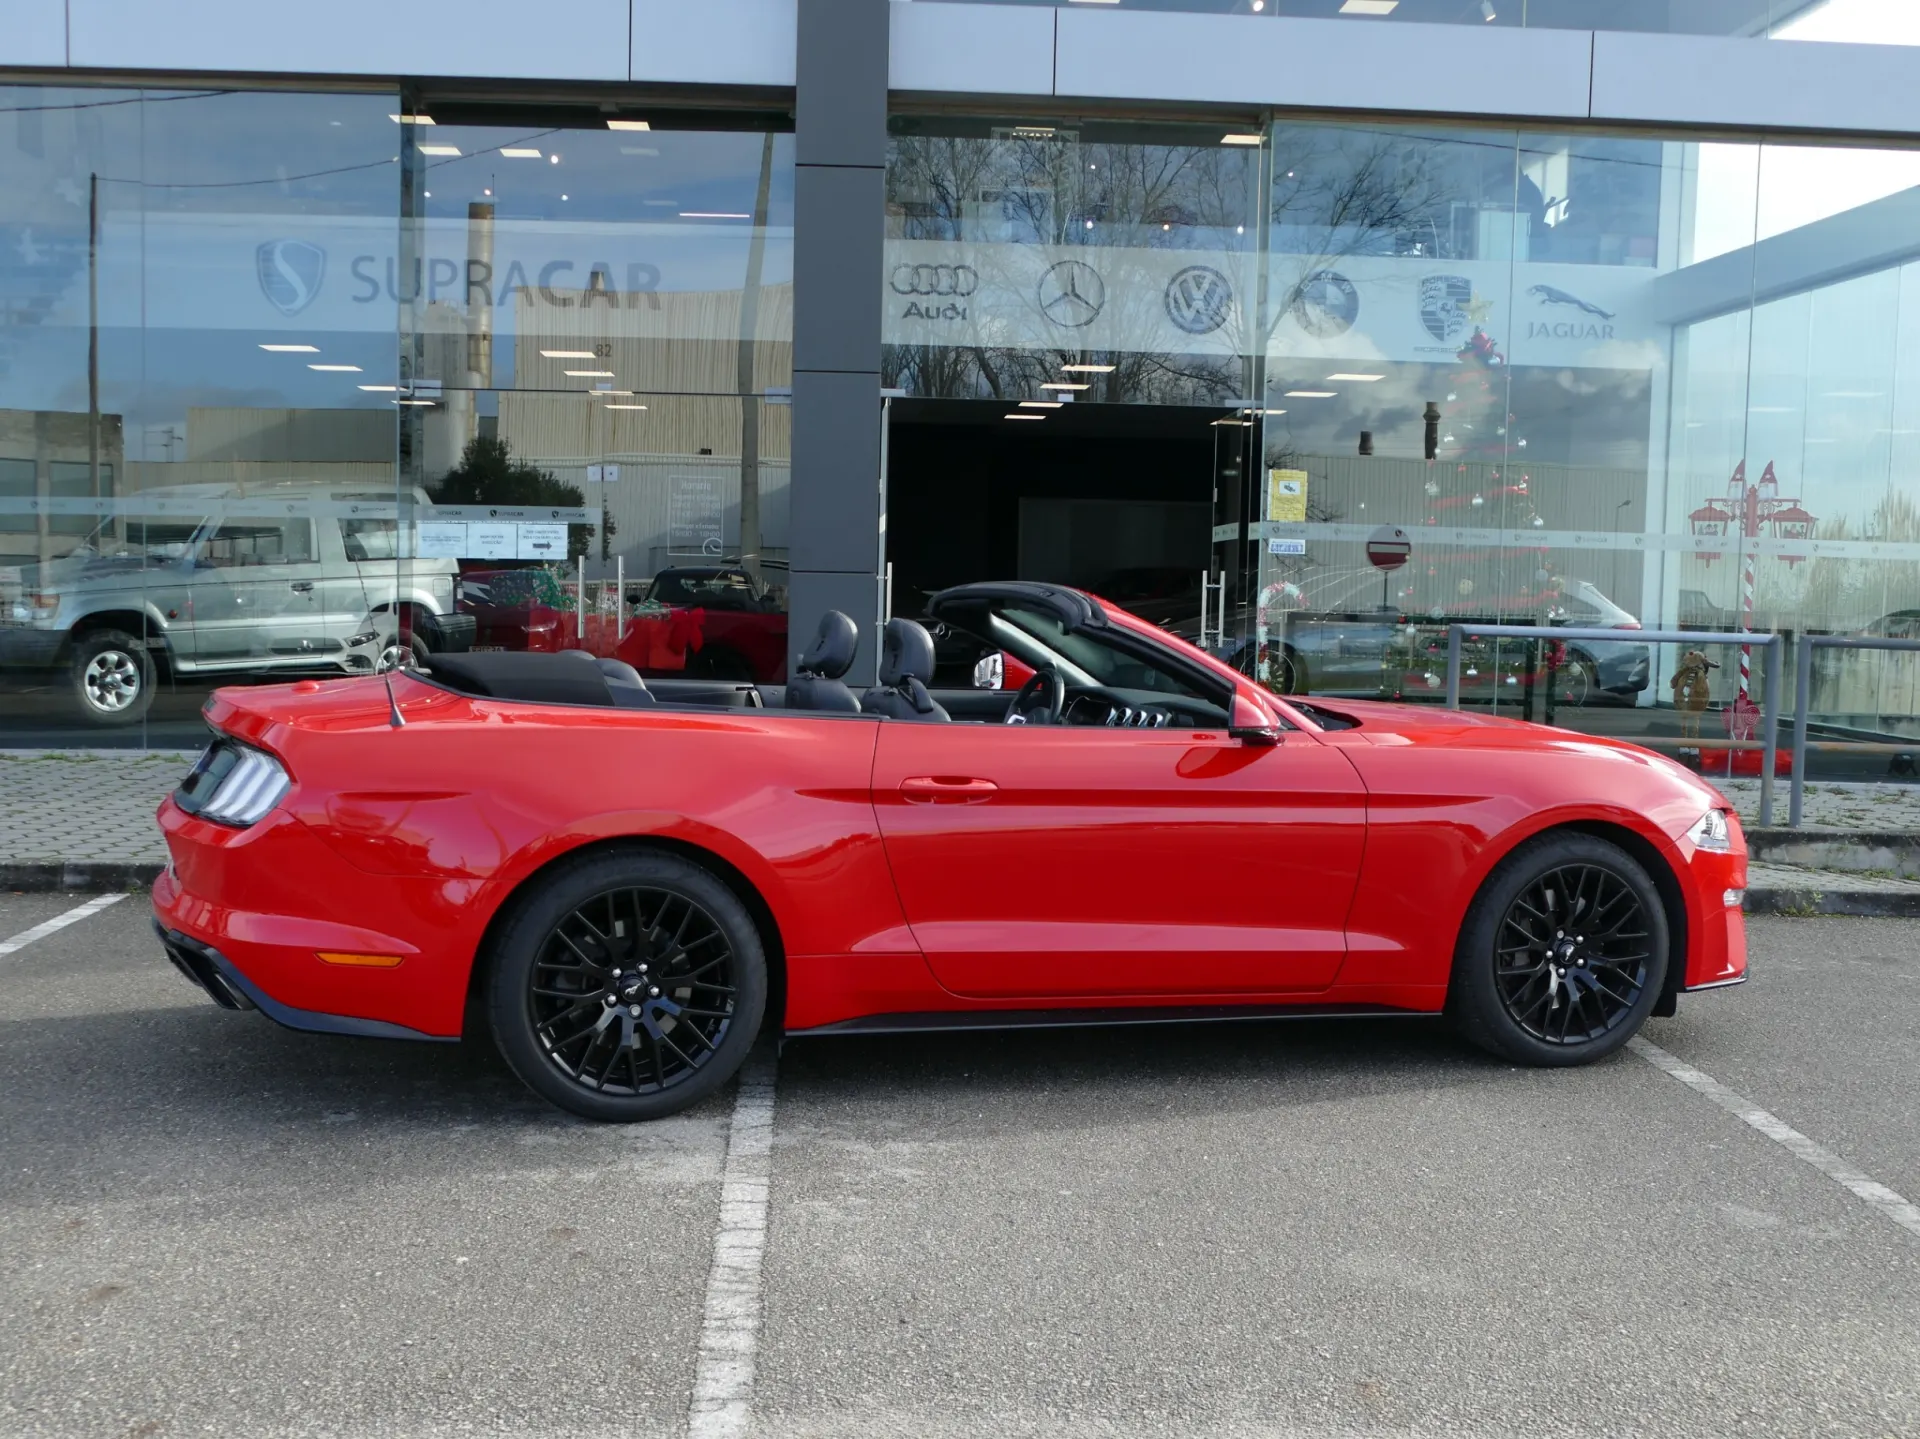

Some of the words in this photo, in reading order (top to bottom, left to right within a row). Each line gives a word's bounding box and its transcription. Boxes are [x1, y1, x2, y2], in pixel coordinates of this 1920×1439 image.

[350, 254, 662, 311] SUPRACAR
[902, 301, 967, 321] Audi
[1527, 321, 1615, 341] JAGUAR
[595, 344, 612, 358] 82
